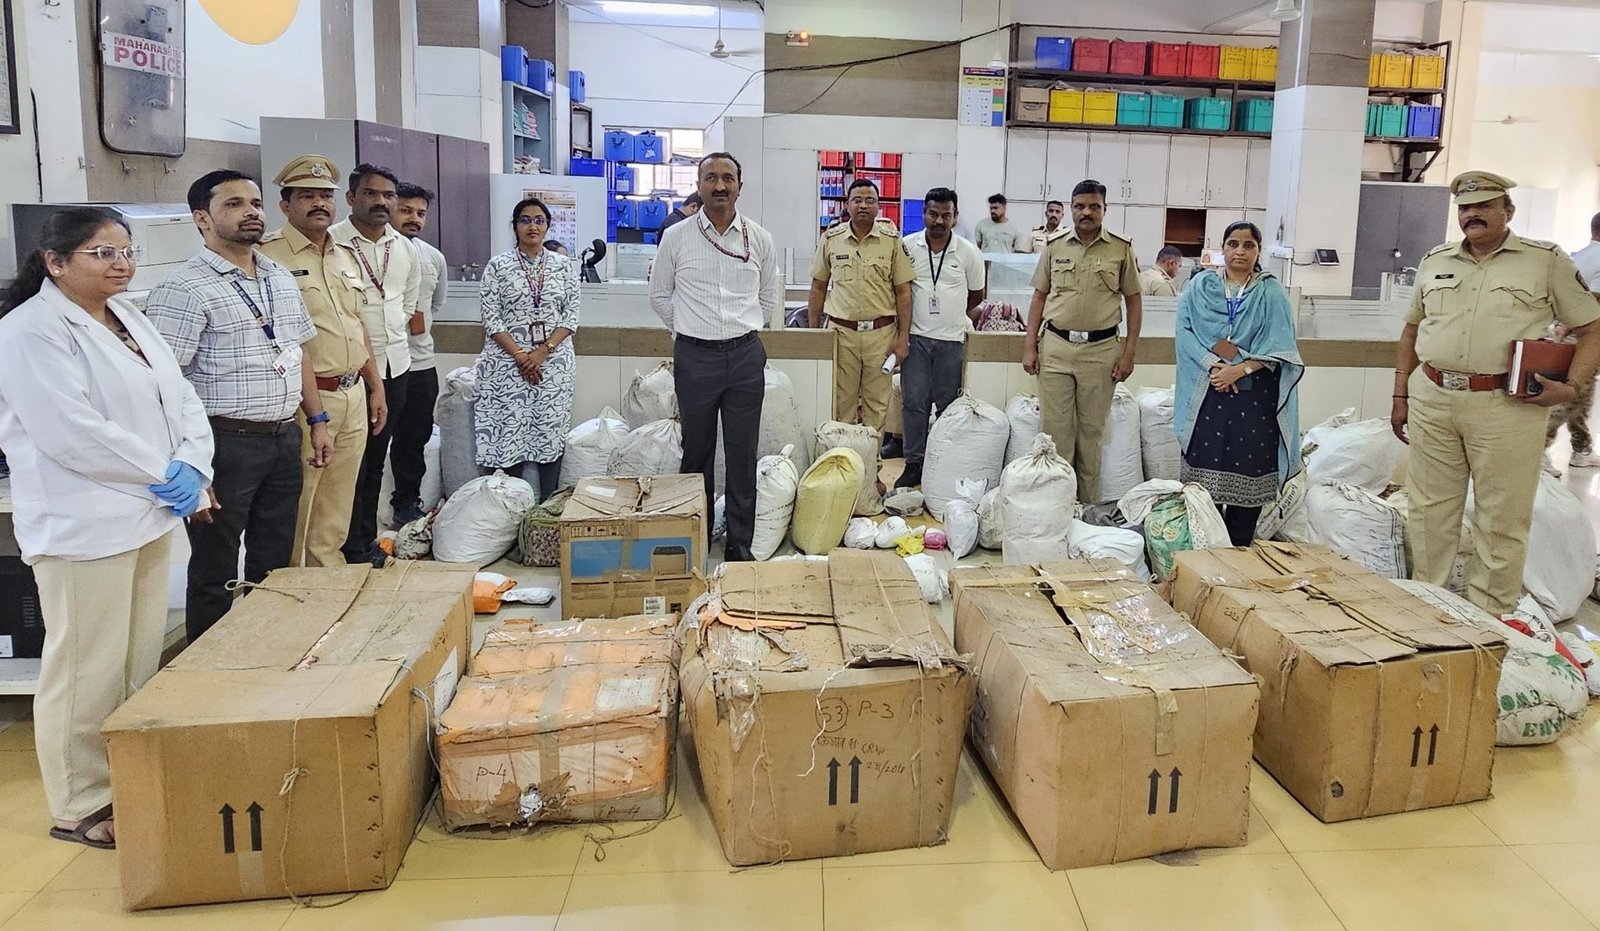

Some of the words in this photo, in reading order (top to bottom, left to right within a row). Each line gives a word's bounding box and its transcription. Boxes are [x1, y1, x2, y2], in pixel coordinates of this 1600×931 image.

[114, 46, 181, 75] POLICE
[858, 700, 894, 719] P-3
[476, 763, 506, 782] P-4
